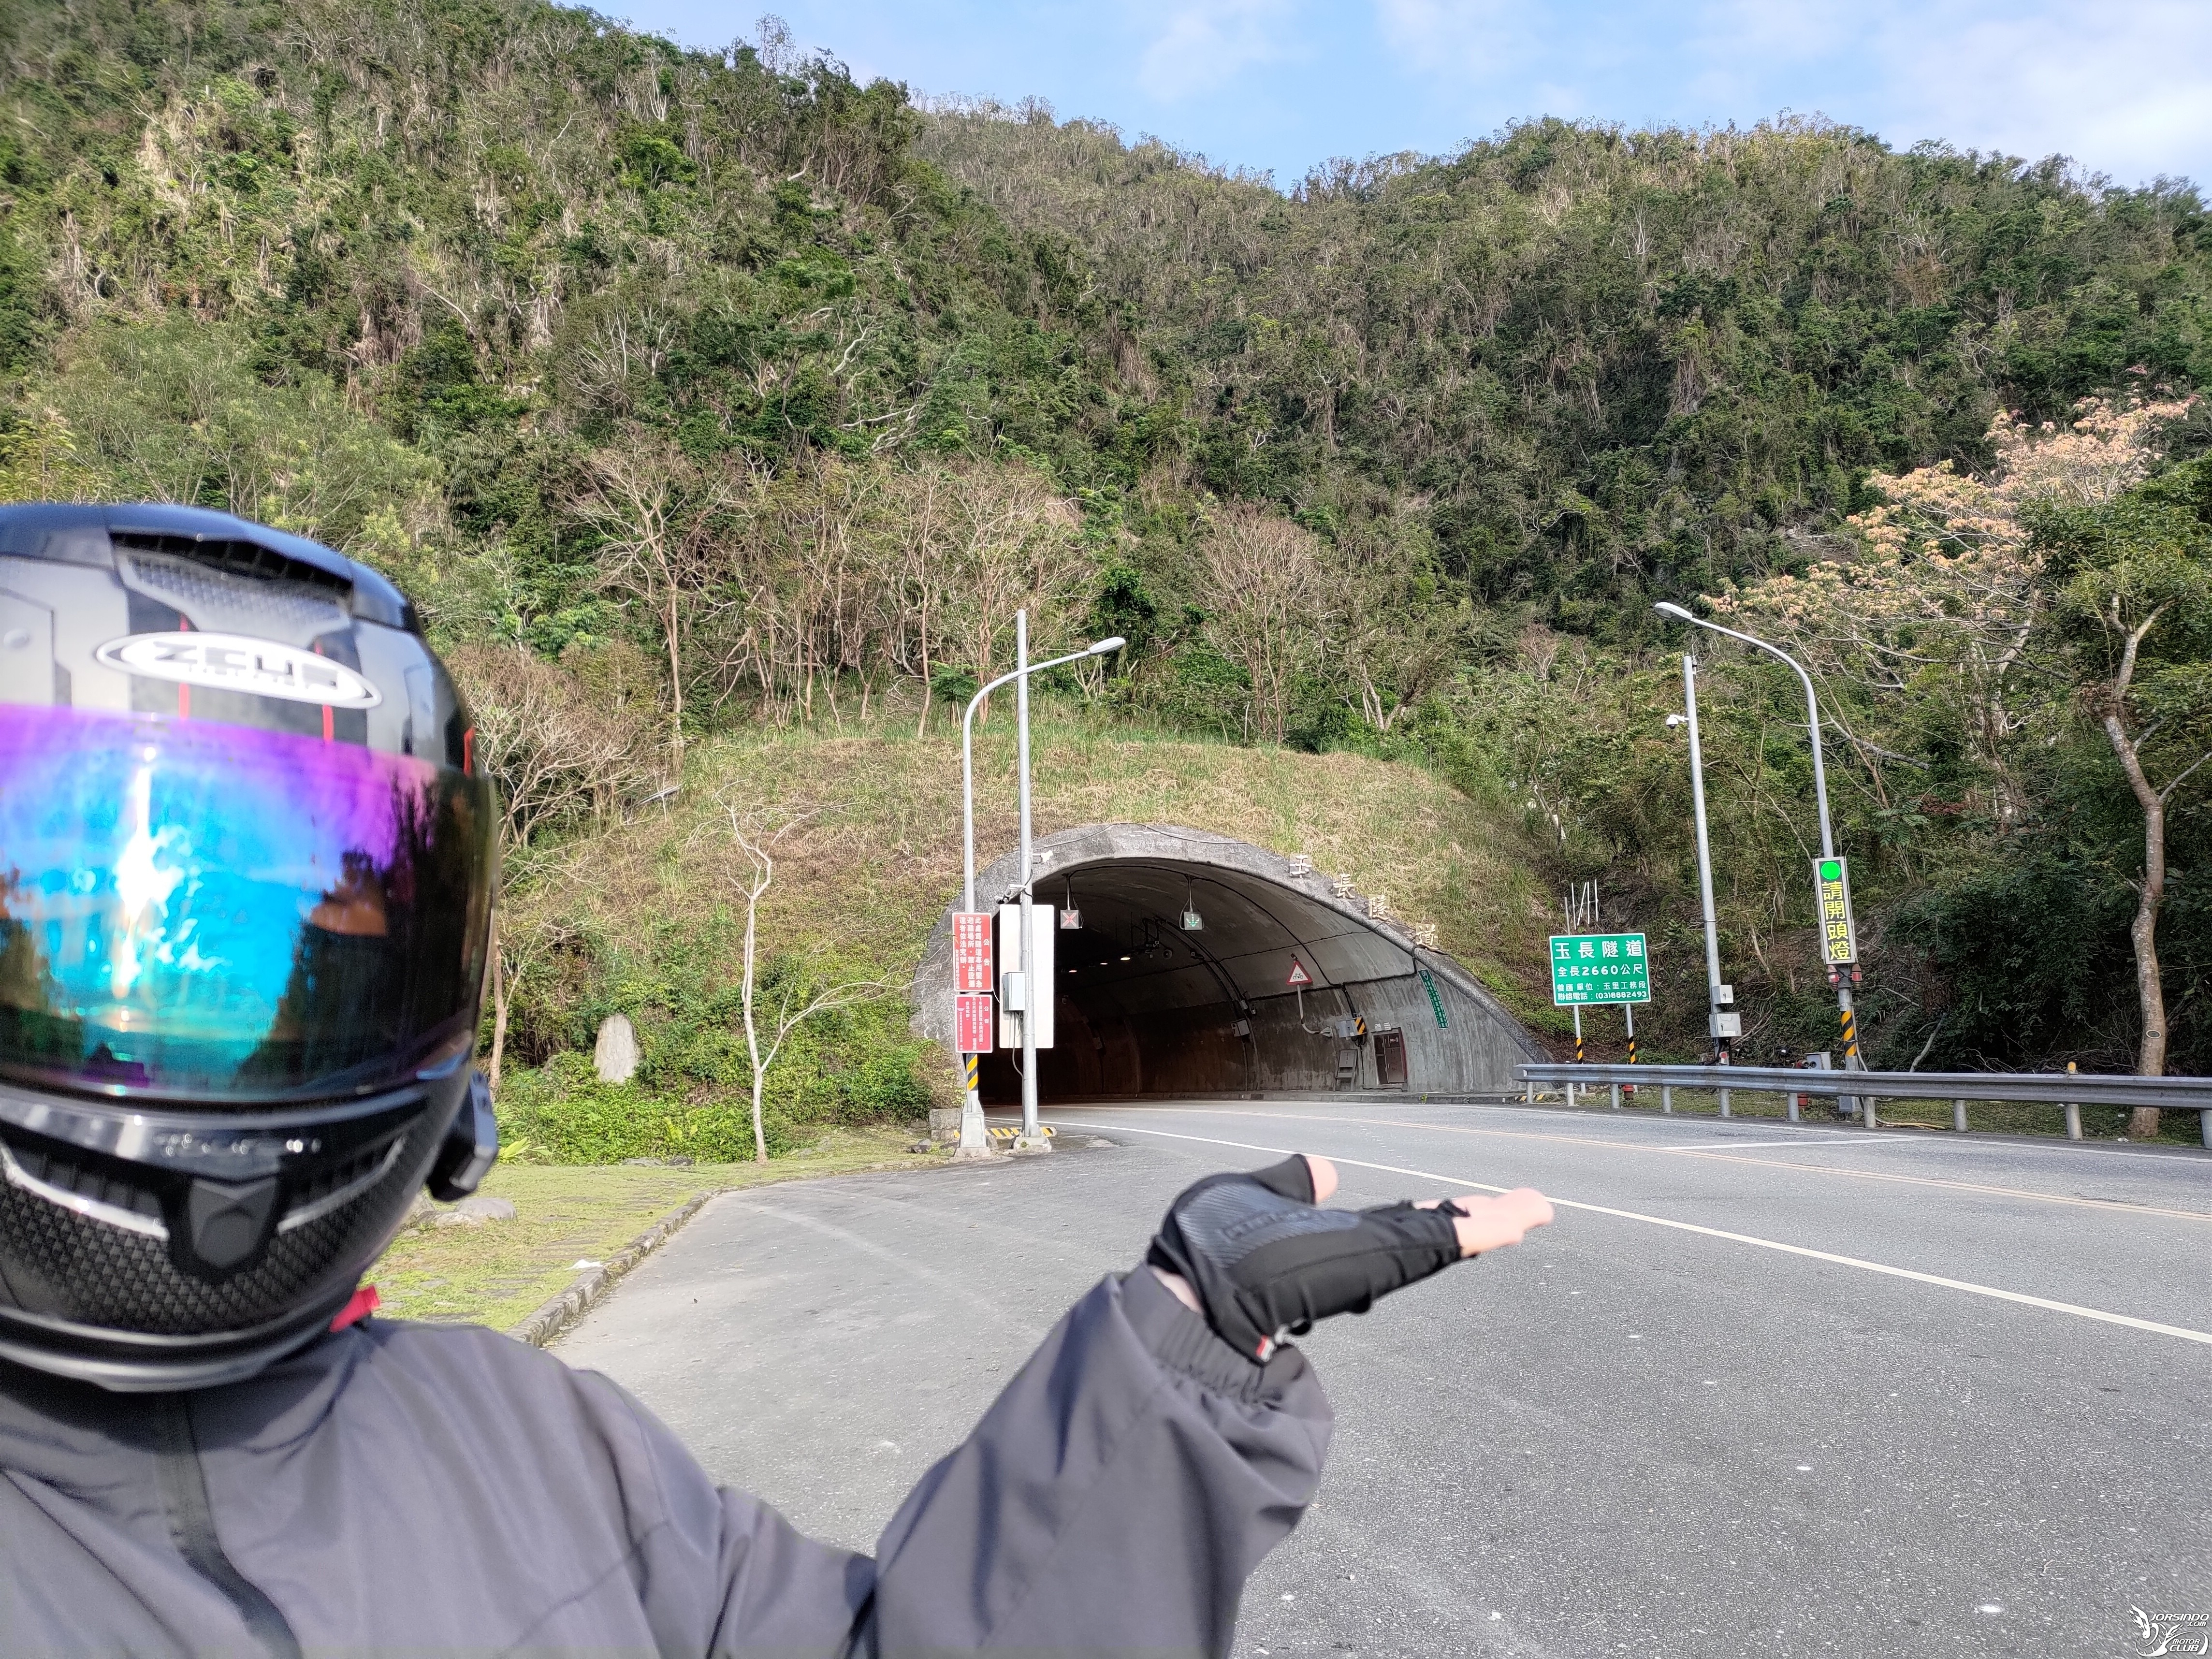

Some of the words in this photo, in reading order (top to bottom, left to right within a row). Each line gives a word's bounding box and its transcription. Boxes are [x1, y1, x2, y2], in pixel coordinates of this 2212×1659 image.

[1289, 854, 1439, 951] 玉長隧道
[1821, 881, 1851, 960] 請開頭燈
[983, 938, 990, 966] 公告
[1555, 940, 1644, 960] 玉長隧道
[1557, 963, 1644, 977] 全長2660公尺
